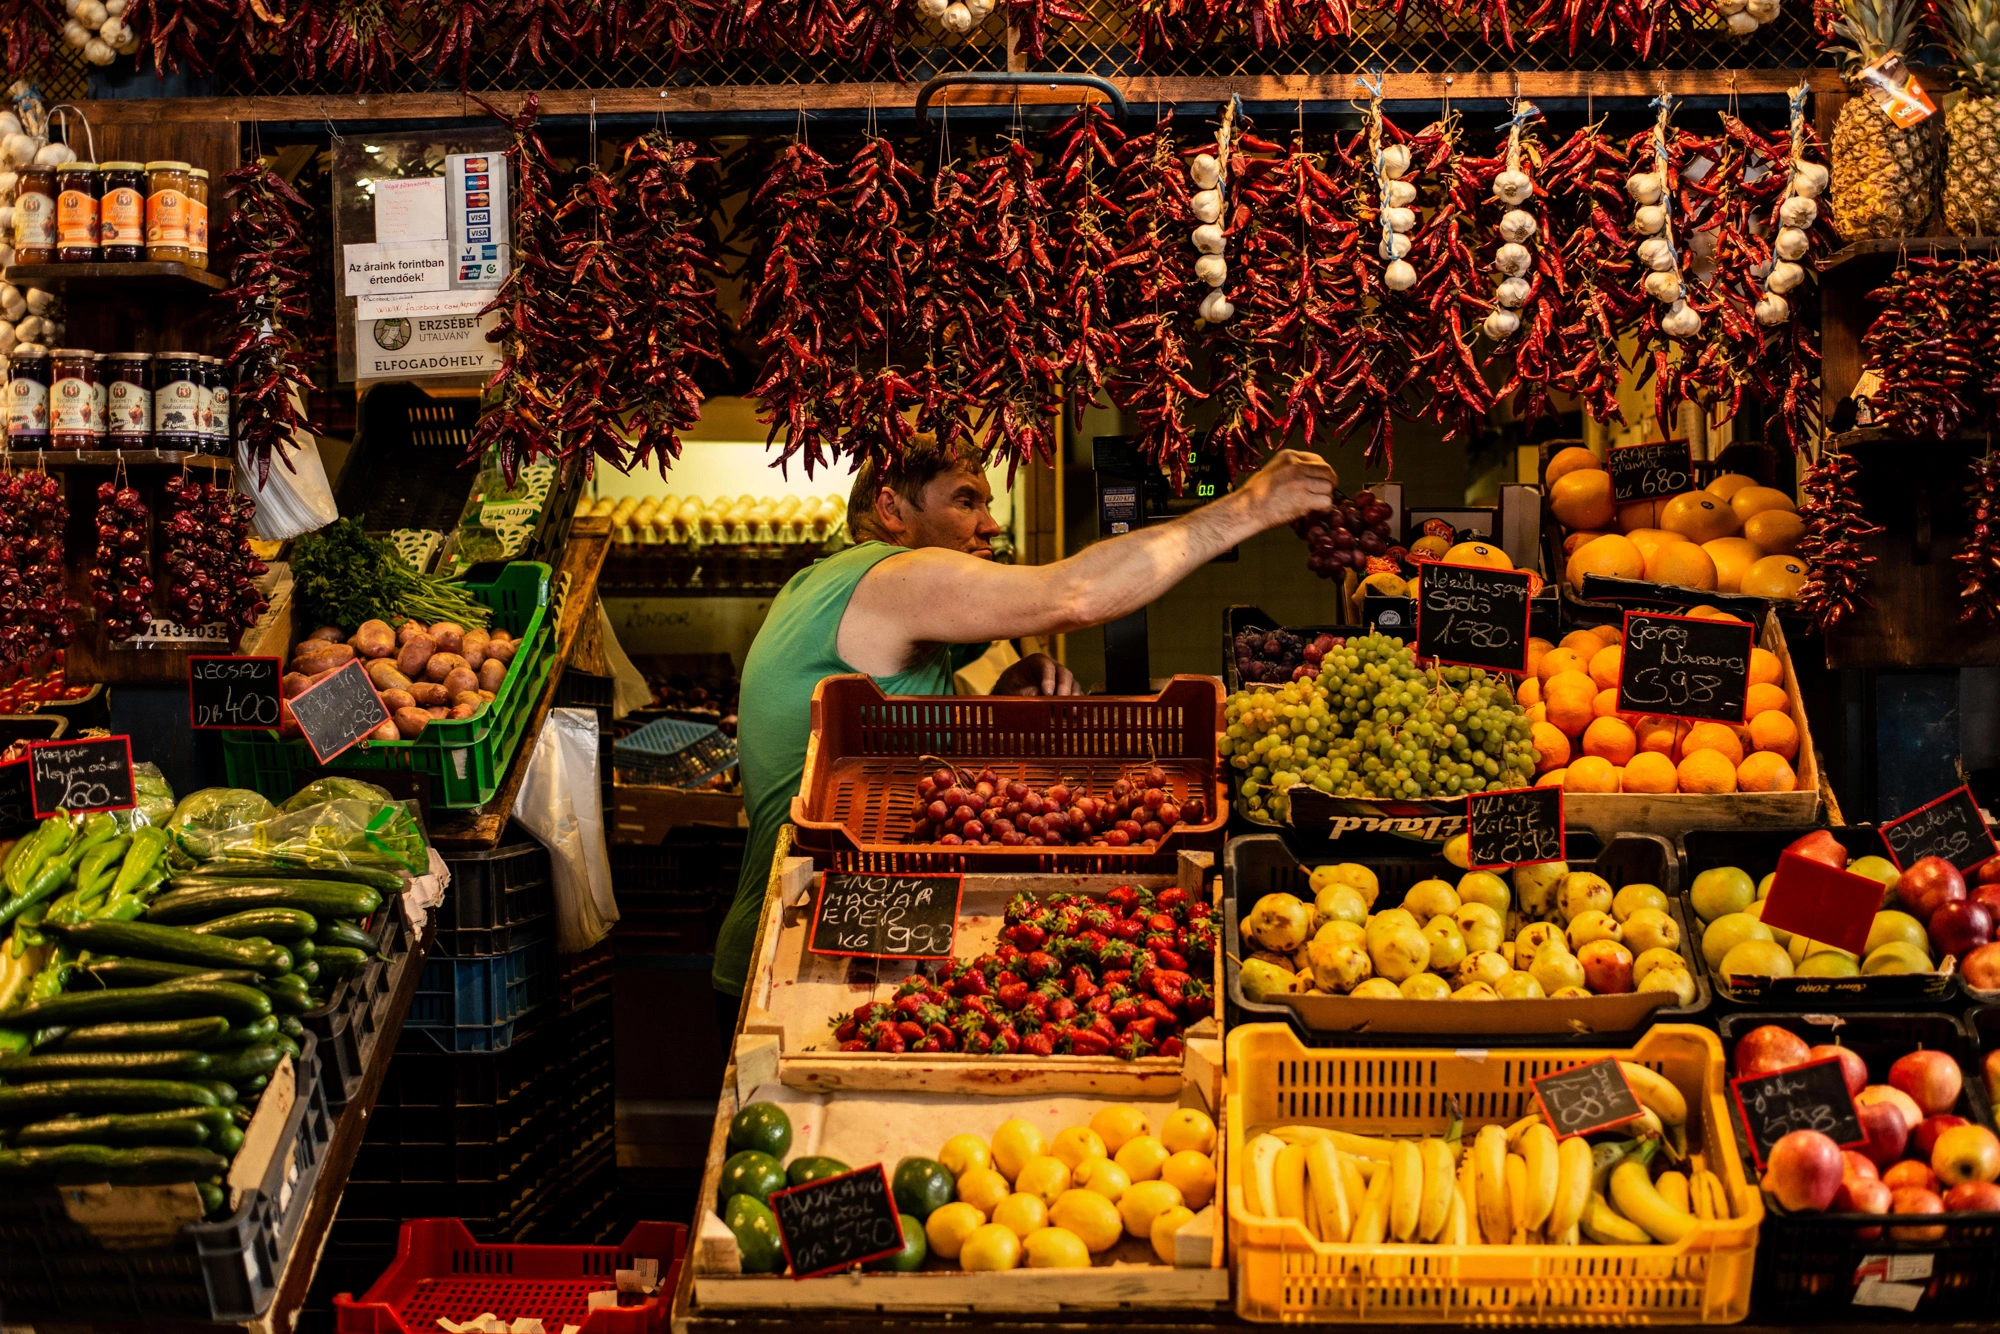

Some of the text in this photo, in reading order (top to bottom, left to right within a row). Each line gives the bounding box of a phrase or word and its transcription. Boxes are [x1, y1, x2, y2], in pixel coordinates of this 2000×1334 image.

[348, 260, 444, 273] Az áraink forintban
[370, 272, 424, 285] értendőek!
[418, 317, 482, 331] ERZSÉBET
[419, 331, 470, 342] UTALVÁNY
[375, 355, 484, 371] ELFOGADÓHELY
[1198, 485, 1215, 496] 0.0
[226, 686, 279, 724] 400
[1328, 815, 1468, 840] tland
[822, 902, 908, 930] EPER
[837, 930, 869, 948] KG
